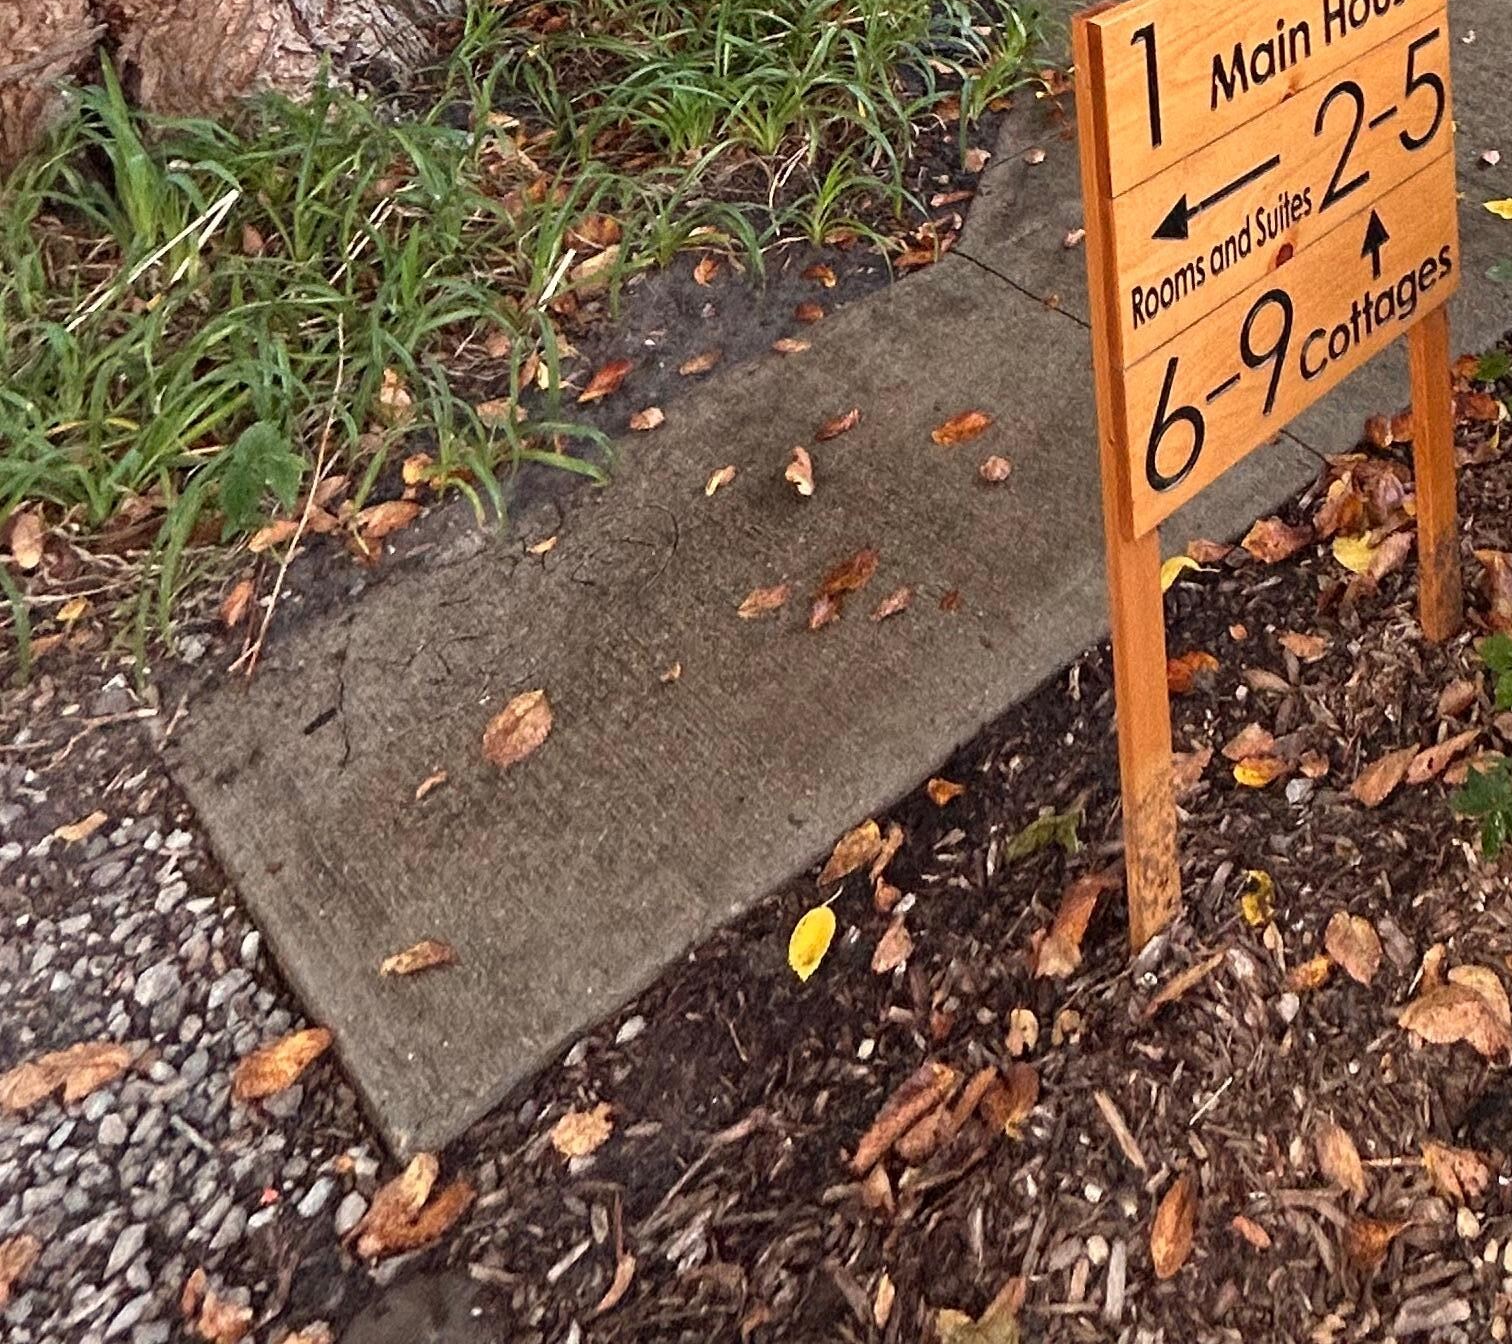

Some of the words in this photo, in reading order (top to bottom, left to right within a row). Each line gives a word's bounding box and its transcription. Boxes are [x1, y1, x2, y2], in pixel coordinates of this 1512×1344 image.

[1130, 22, 1162, 149] 1
[1210, 20, 1311, 111] Main
[1131, 256, 1206, 330] Rooms
[1210, 215, 1252, 276] and
[1254, 183, 1313, 249] Suites
[1313, 28, 1446, 214] 2-5
[1144, 289, 1294, 493] 6-9
[1299, 242, 1453, 382] Cottages
